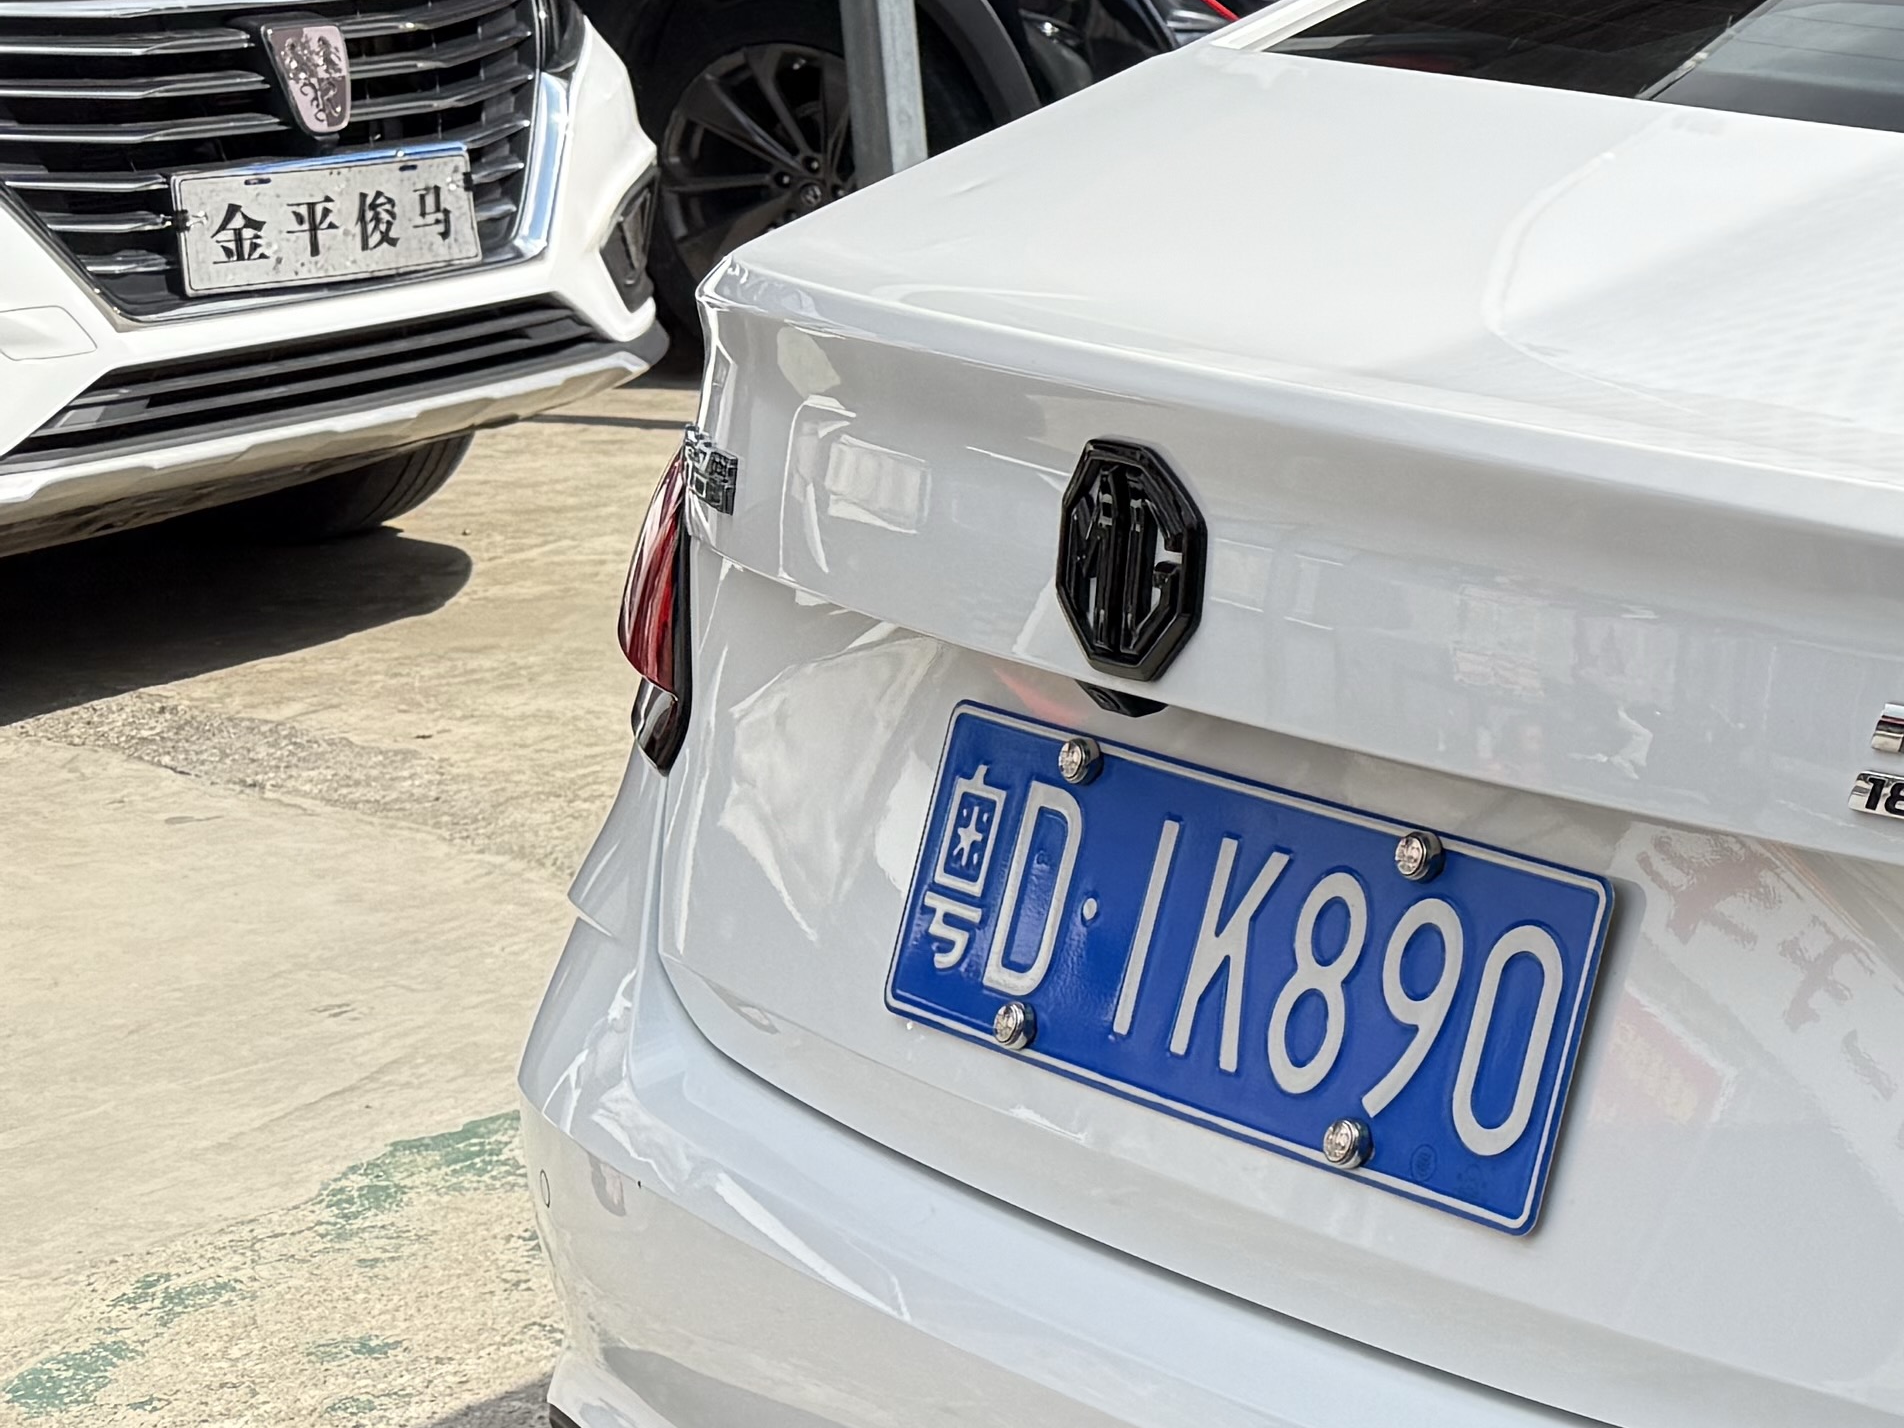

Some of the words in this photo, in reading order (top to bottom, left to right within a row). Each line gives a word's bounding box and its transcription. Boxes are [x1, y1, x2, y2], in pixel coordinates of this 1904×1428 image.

[210, 184, 451, 264] 金平俊马
[1060, 446, 1200, 674] MG
